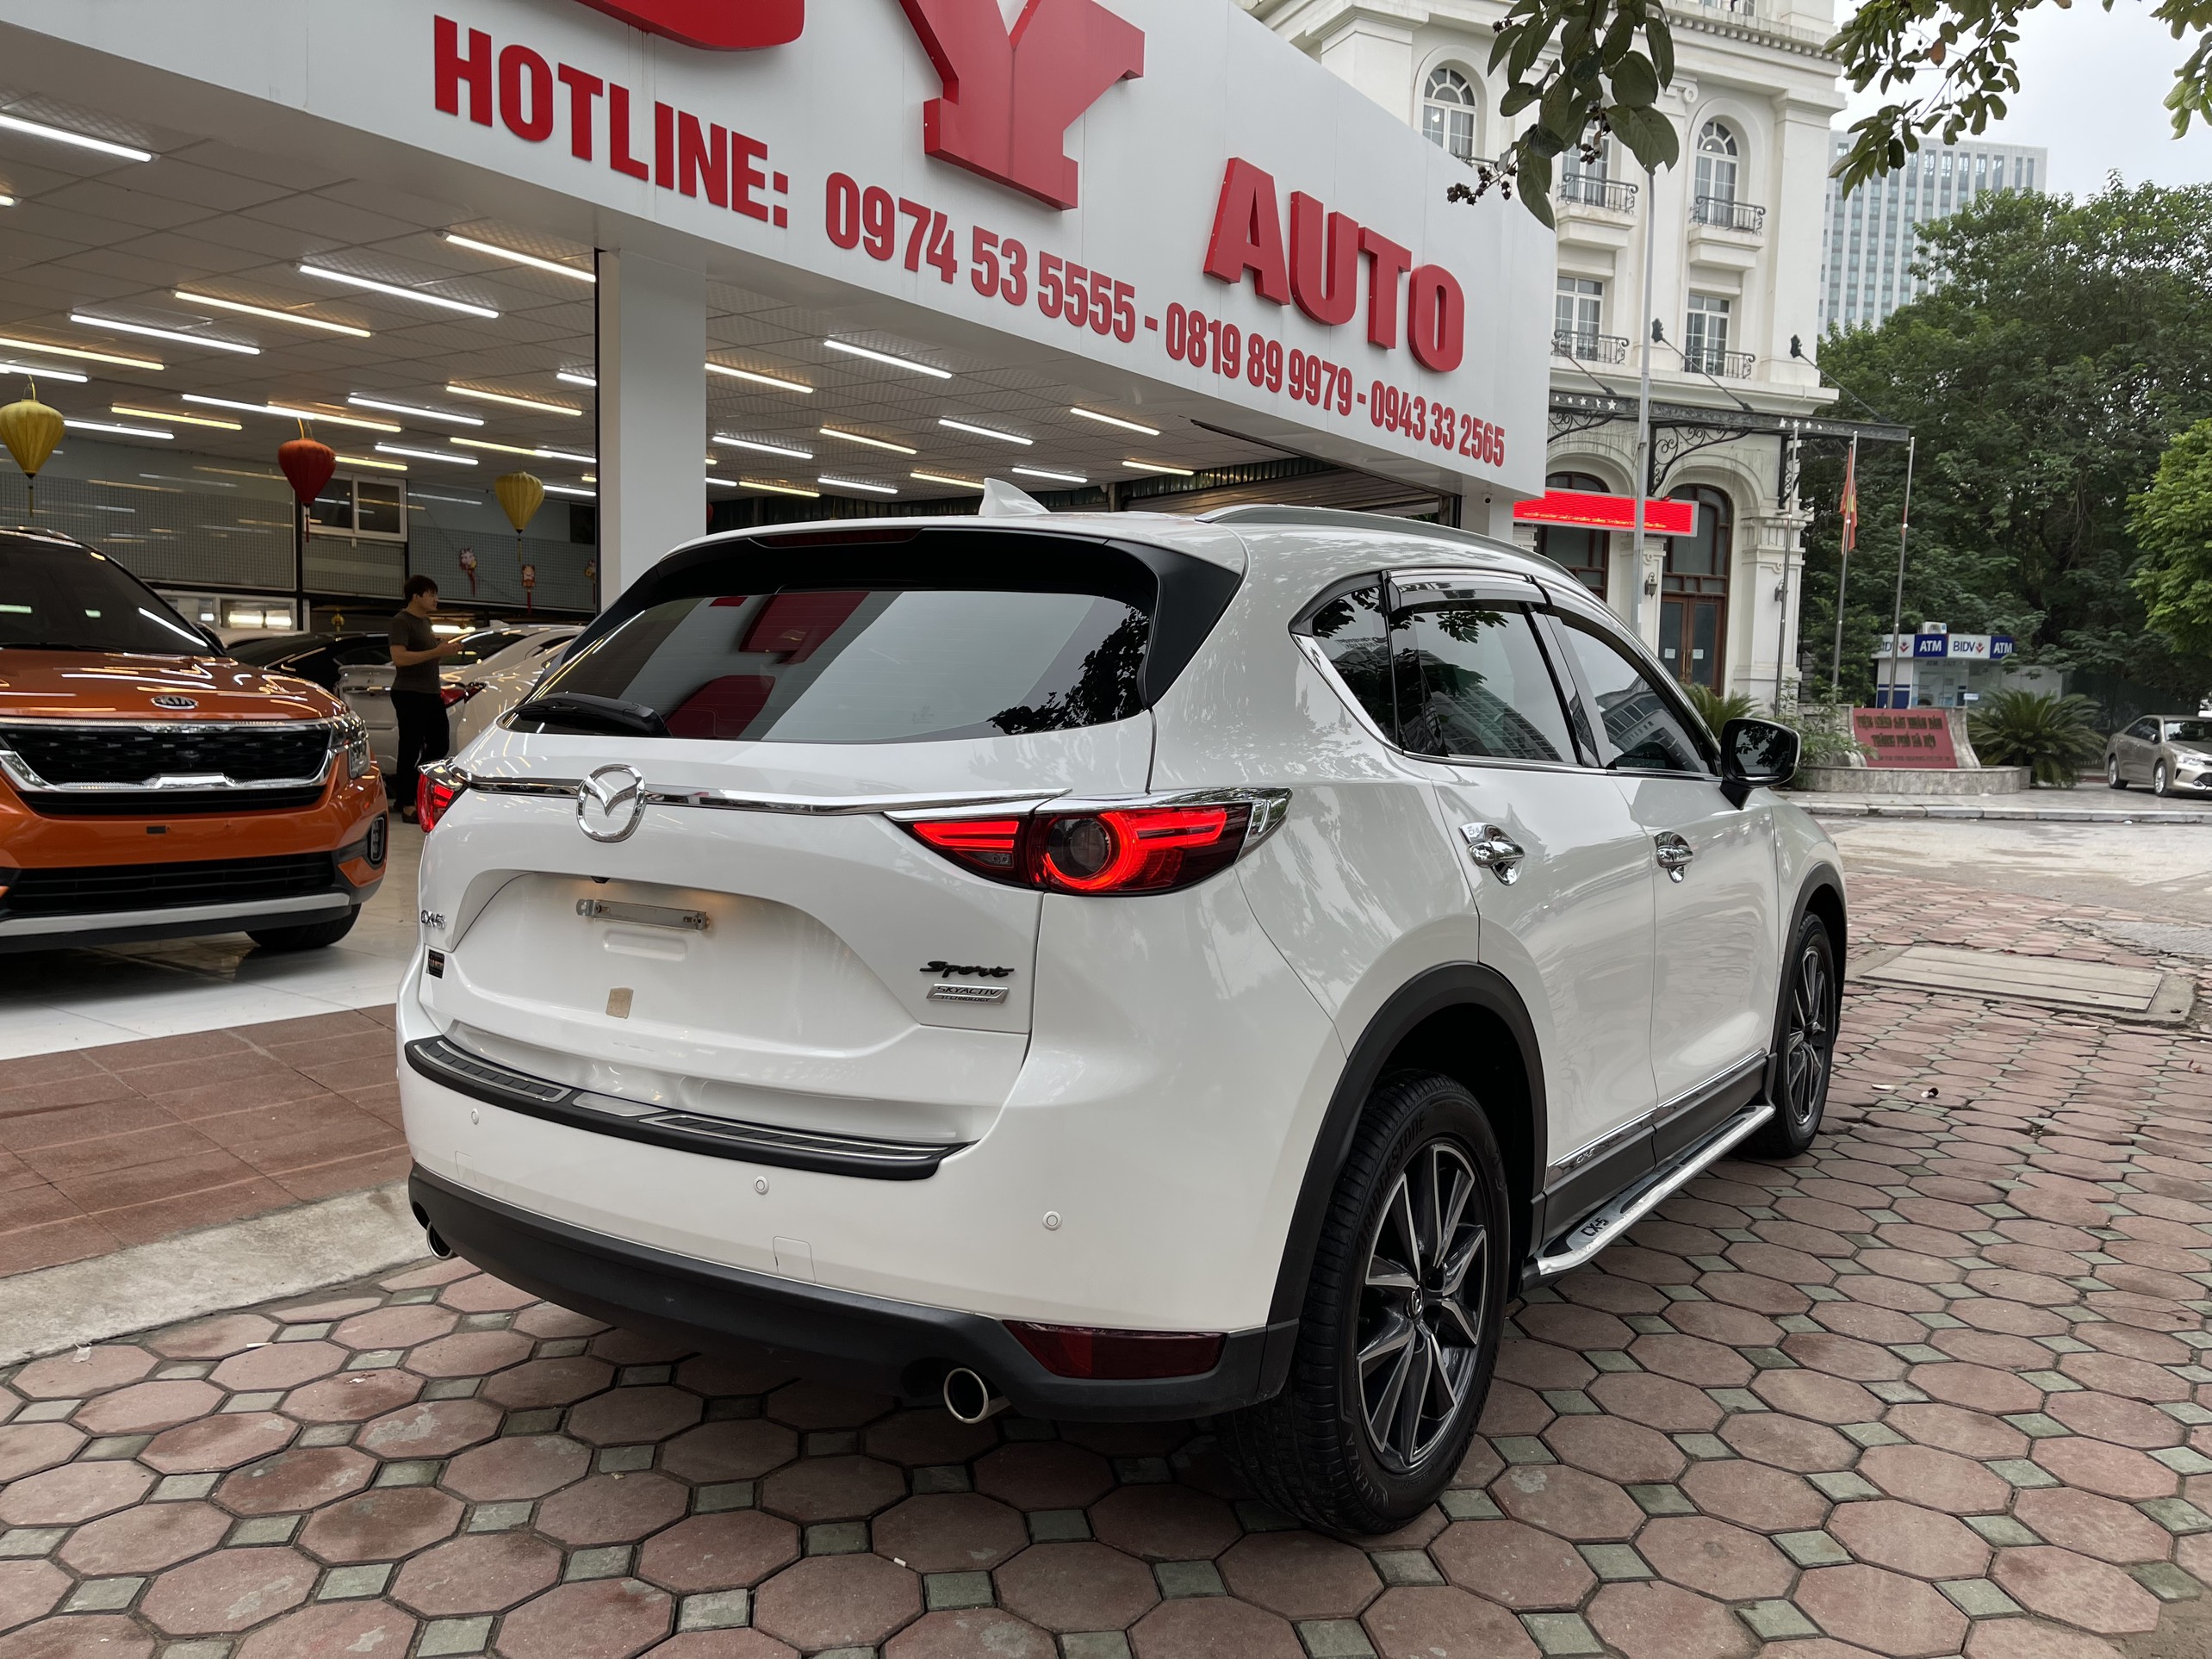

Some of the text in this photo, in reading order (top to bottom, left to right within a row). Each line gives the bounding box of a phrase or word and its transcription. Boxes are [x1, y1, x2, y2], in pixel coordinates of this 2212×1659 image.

[434, 15, 789, 228] HOTLINE:
[826, 172, 958, 283] 0974
[971, 226, 1028, 306] 53
[1038, 251, 1135, 343] 5555
[1166, 302, 1241, 379] 0819
[1247, 333, 1283, 393] 89
[1289, 349, 1353, 416] 9979
[1370, 381, 1427, 441] 0943
[1430, 402, 1456, 450] 33
[1459, 413, 1506, 467] 2565
[1203, 157, 1465, 373] AUTO
[1919, 640, 1942, 652] ATM
[1953, 641, 1976, 652] BIDV
[1993, 642, 2013, 654] ATM
[919, 960, 1015, 979] Sport
[936, 986, 1000, 996] SKYACTIV
[1580, 1217, 1610, 1237] CX-5
